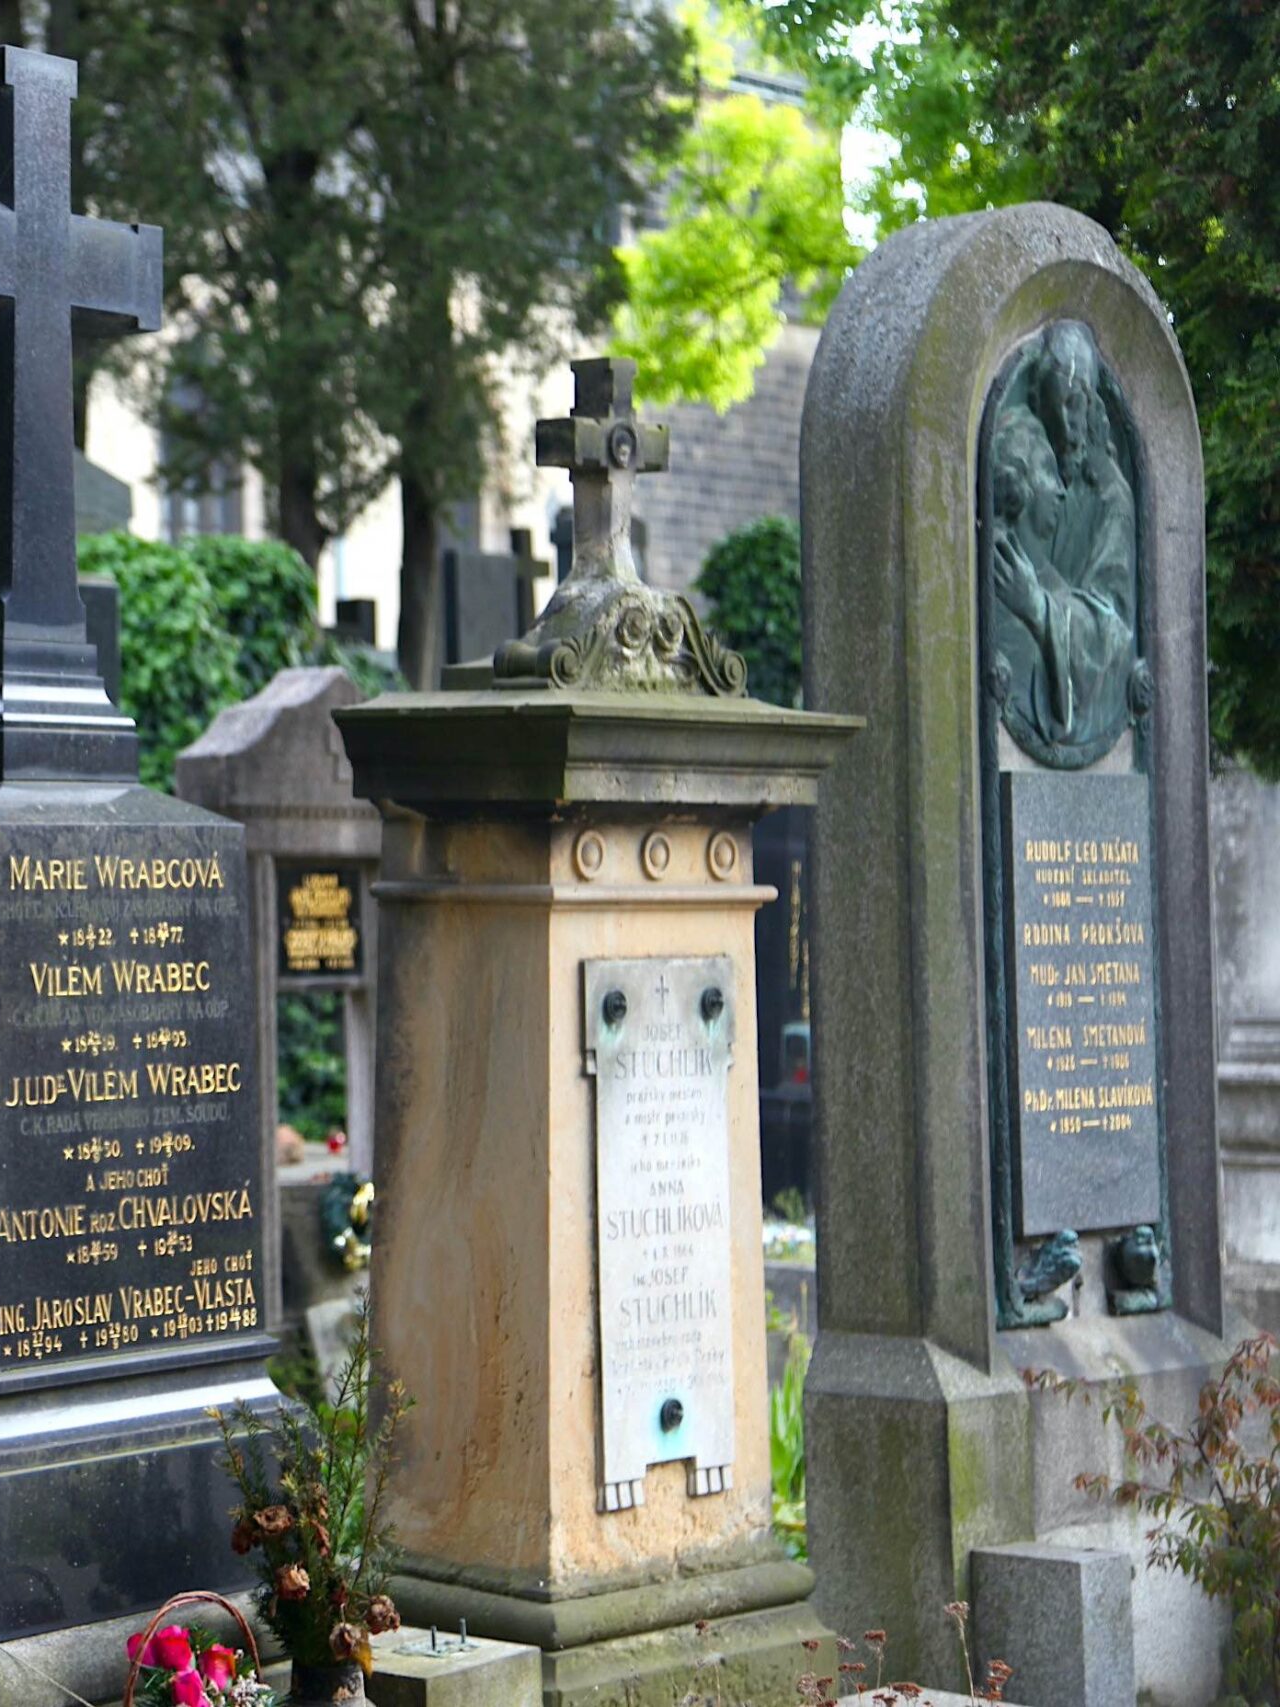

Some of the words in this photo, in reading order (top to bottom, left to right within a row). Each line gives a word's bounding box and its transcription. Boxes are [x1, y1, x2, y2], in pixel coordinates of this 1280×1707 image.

[1025, 840, 1071, 863] RUDOLF
[10, 855, 88, 890] MARIE
[94, 851, 224, 890] WRABCOVÁ
[1023, 922, 1070, 946] RODINA
[30, 958, 103, 996] VILÉM
[111, 960, 210, 994] WRABEC
[1064, 963, 1086, 985] JAN
[1090, 961, 1140, 985] SMETANA
[1027, 1027, 1072, 1049] MILENA
[1083, 1016, 1146, 1047] SMETANOVÁ
[146, 1062, 241, 1096] WRABEC
[1056, 1087, 1095, 1110] MILENA
[85, 1173, 95, 1192] A
[99, 1168, 134, 1191] JEHO
[649, 1179, 685, 1197] ANNA
[118, 1180, 254, 1230] CHVALOVSKÁ
[190, 1257, 218, 1277] JEHO
[0, 1303, 30, 1335] ING.
[31, 1292, 113, 1332] JAROSLAV
